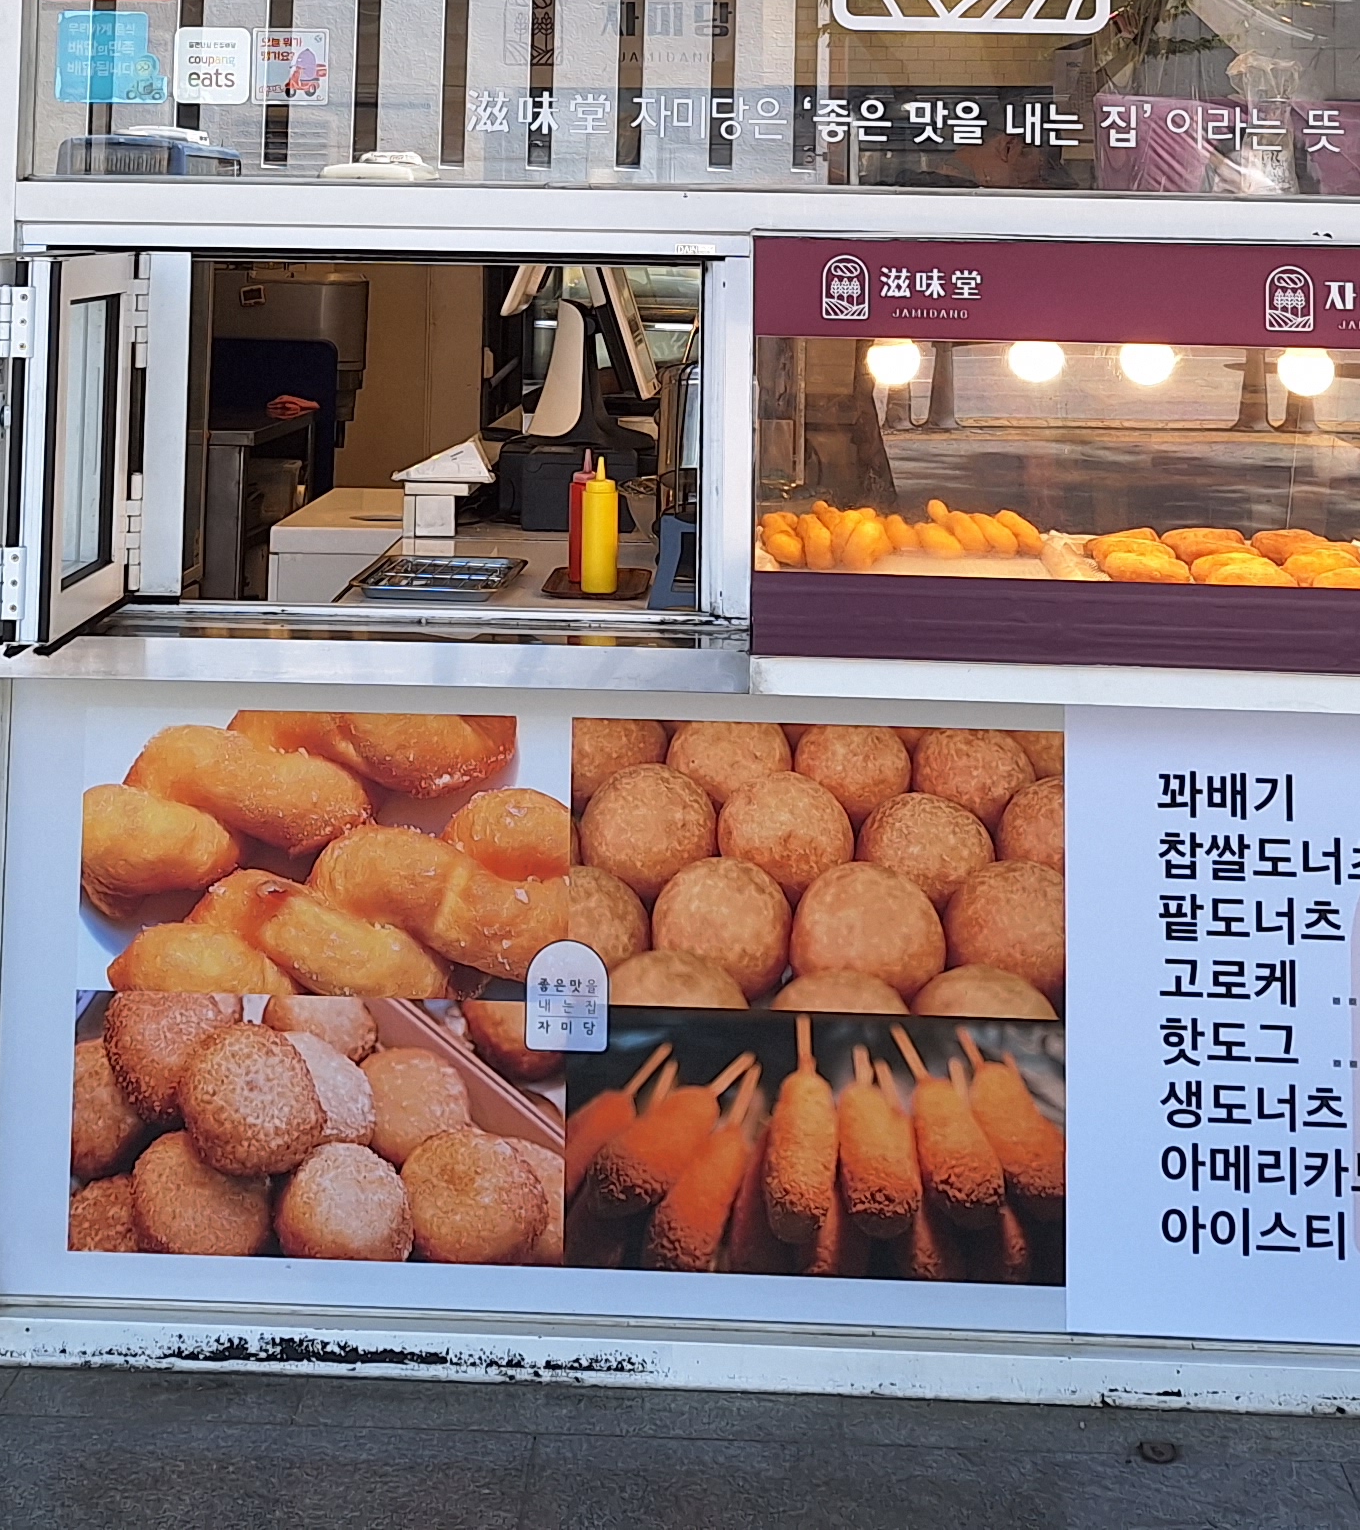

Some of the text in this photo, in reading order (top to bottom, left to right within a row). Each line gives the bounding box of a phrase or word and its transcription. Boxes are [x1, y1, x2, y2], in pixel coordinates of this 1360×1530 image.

[600, 1, 733, 37] 자미당
[188, 55, 236, 68] coupang
[188, 69, 236, 88] eats
[468, 90, 612, 134] 滋味堂
[630, 95, 788, 140] 자미당은
[909, 101, 988, 145] 맛을
[1005, 103, 1084, 147] 내는
[1166, 108, 1287, 152] 이라는
[1302, 109, 1345, 153] 뜻
[879, 267, 982, 300] 滋味堂
[891, 308, 969, 320] JAMIDANG
[1157, 770, 1294, 822] 꽈배기
[1158, 893, 1346, 945] 팥도너츠
[1159, 957, 1297, 1008] 고로케
[538, 1020, 596, 1036] 자미당
[1159, 1017, 1299, 1066] 핫도그
[1159, 1080, 1348, 1132] 생도너츠
[1160, 1205, 1346, 1261] 아이스티
